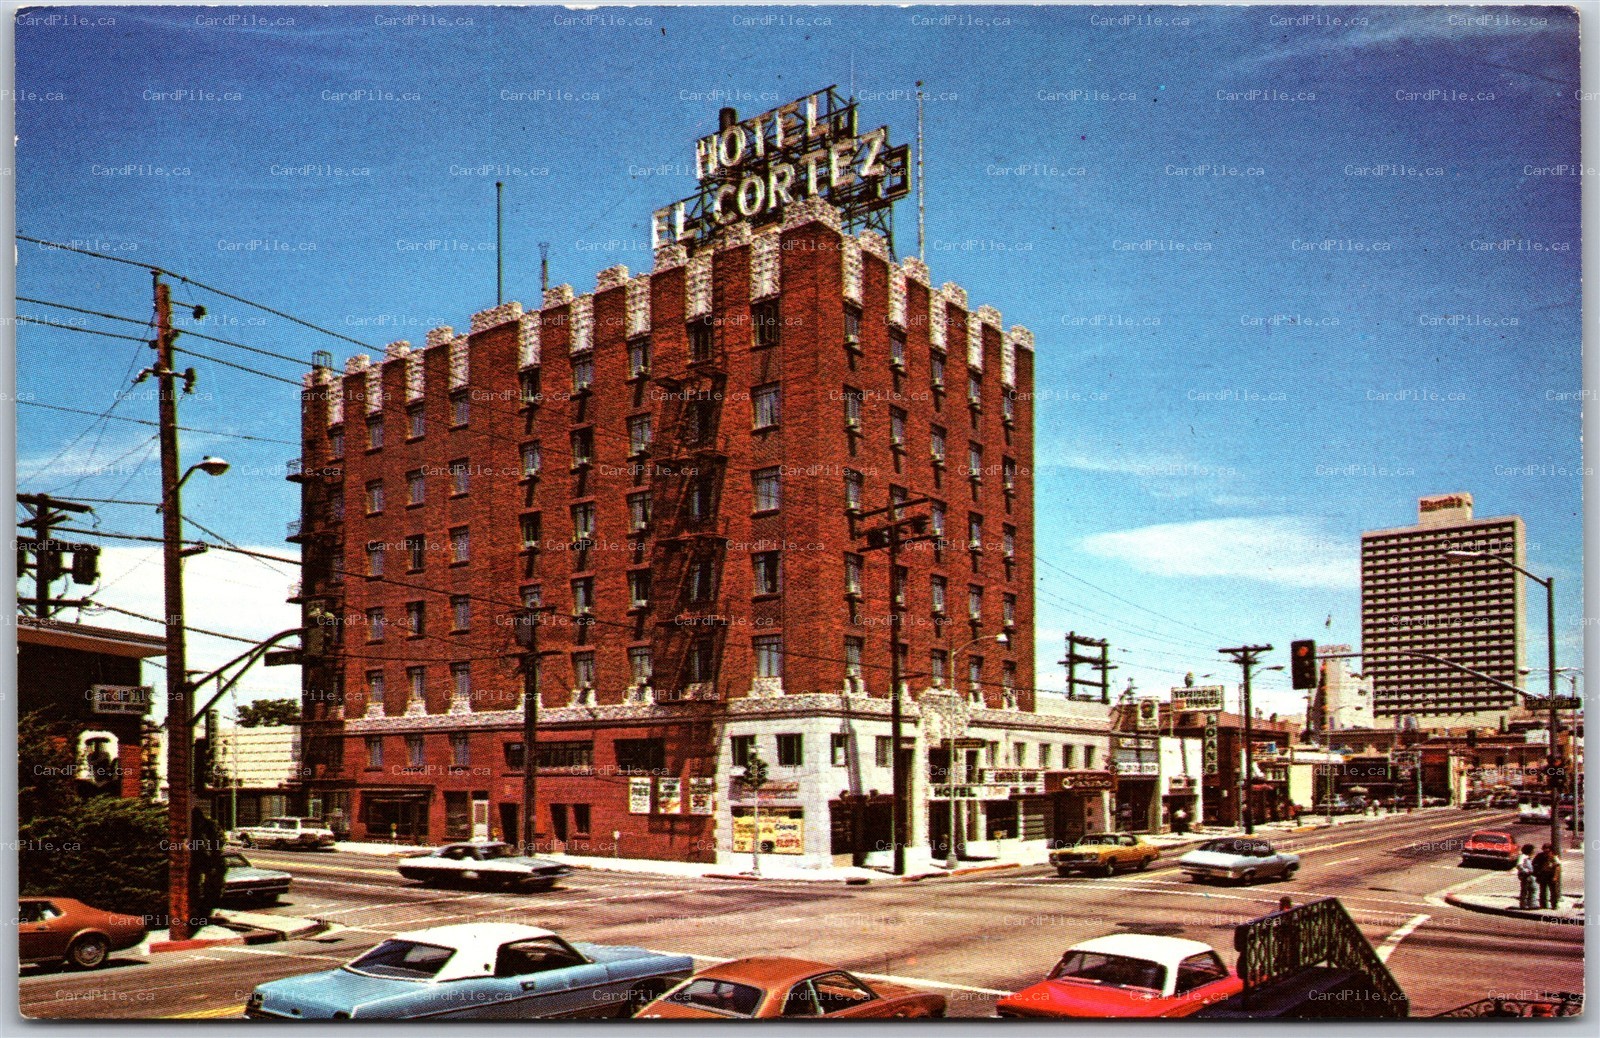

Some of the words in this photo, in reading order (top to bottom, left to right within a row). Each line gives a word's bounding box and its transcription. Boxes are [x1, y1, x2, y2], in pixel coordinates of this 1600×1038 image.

[696, 94, 829, 180] HOTEL
[652, 201, 701, 249] EL
[714, 128, 887, 224] CORTEZ
[934, 786, 976, 798] HOTEL
